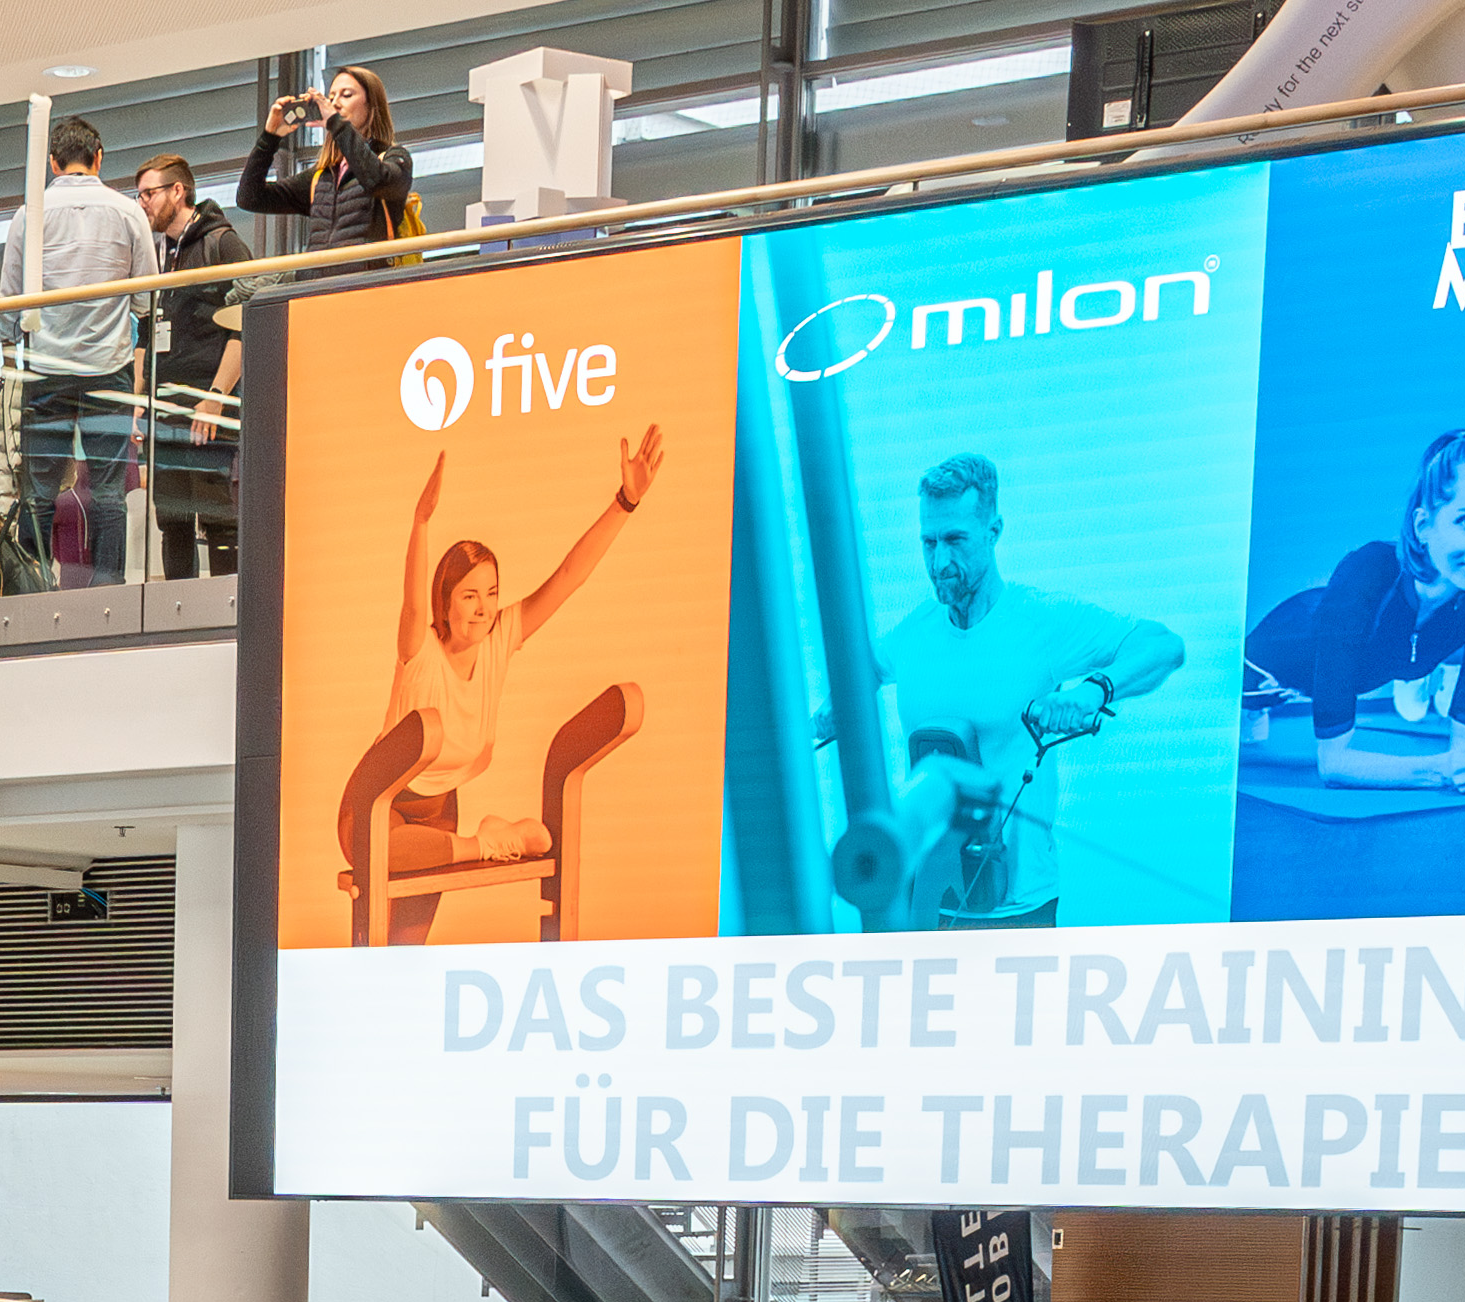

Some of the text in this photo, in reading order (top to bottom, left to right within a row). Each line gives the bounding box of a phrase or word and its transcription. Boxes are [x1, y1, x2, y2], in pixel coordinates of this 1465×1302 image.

[1277, 73, 1300, 98] for
[1295, 47, 1323, 74] the
[1319, 11, 1350, 47] next
[485, 332, 617, 417] five
[443, 963, 629, 1055] DAS
[662, 956, 958, 1050] BESTE
[513, 1072, 691, 1183] FÜR
[728, 1094, 884, 1185] DIE
